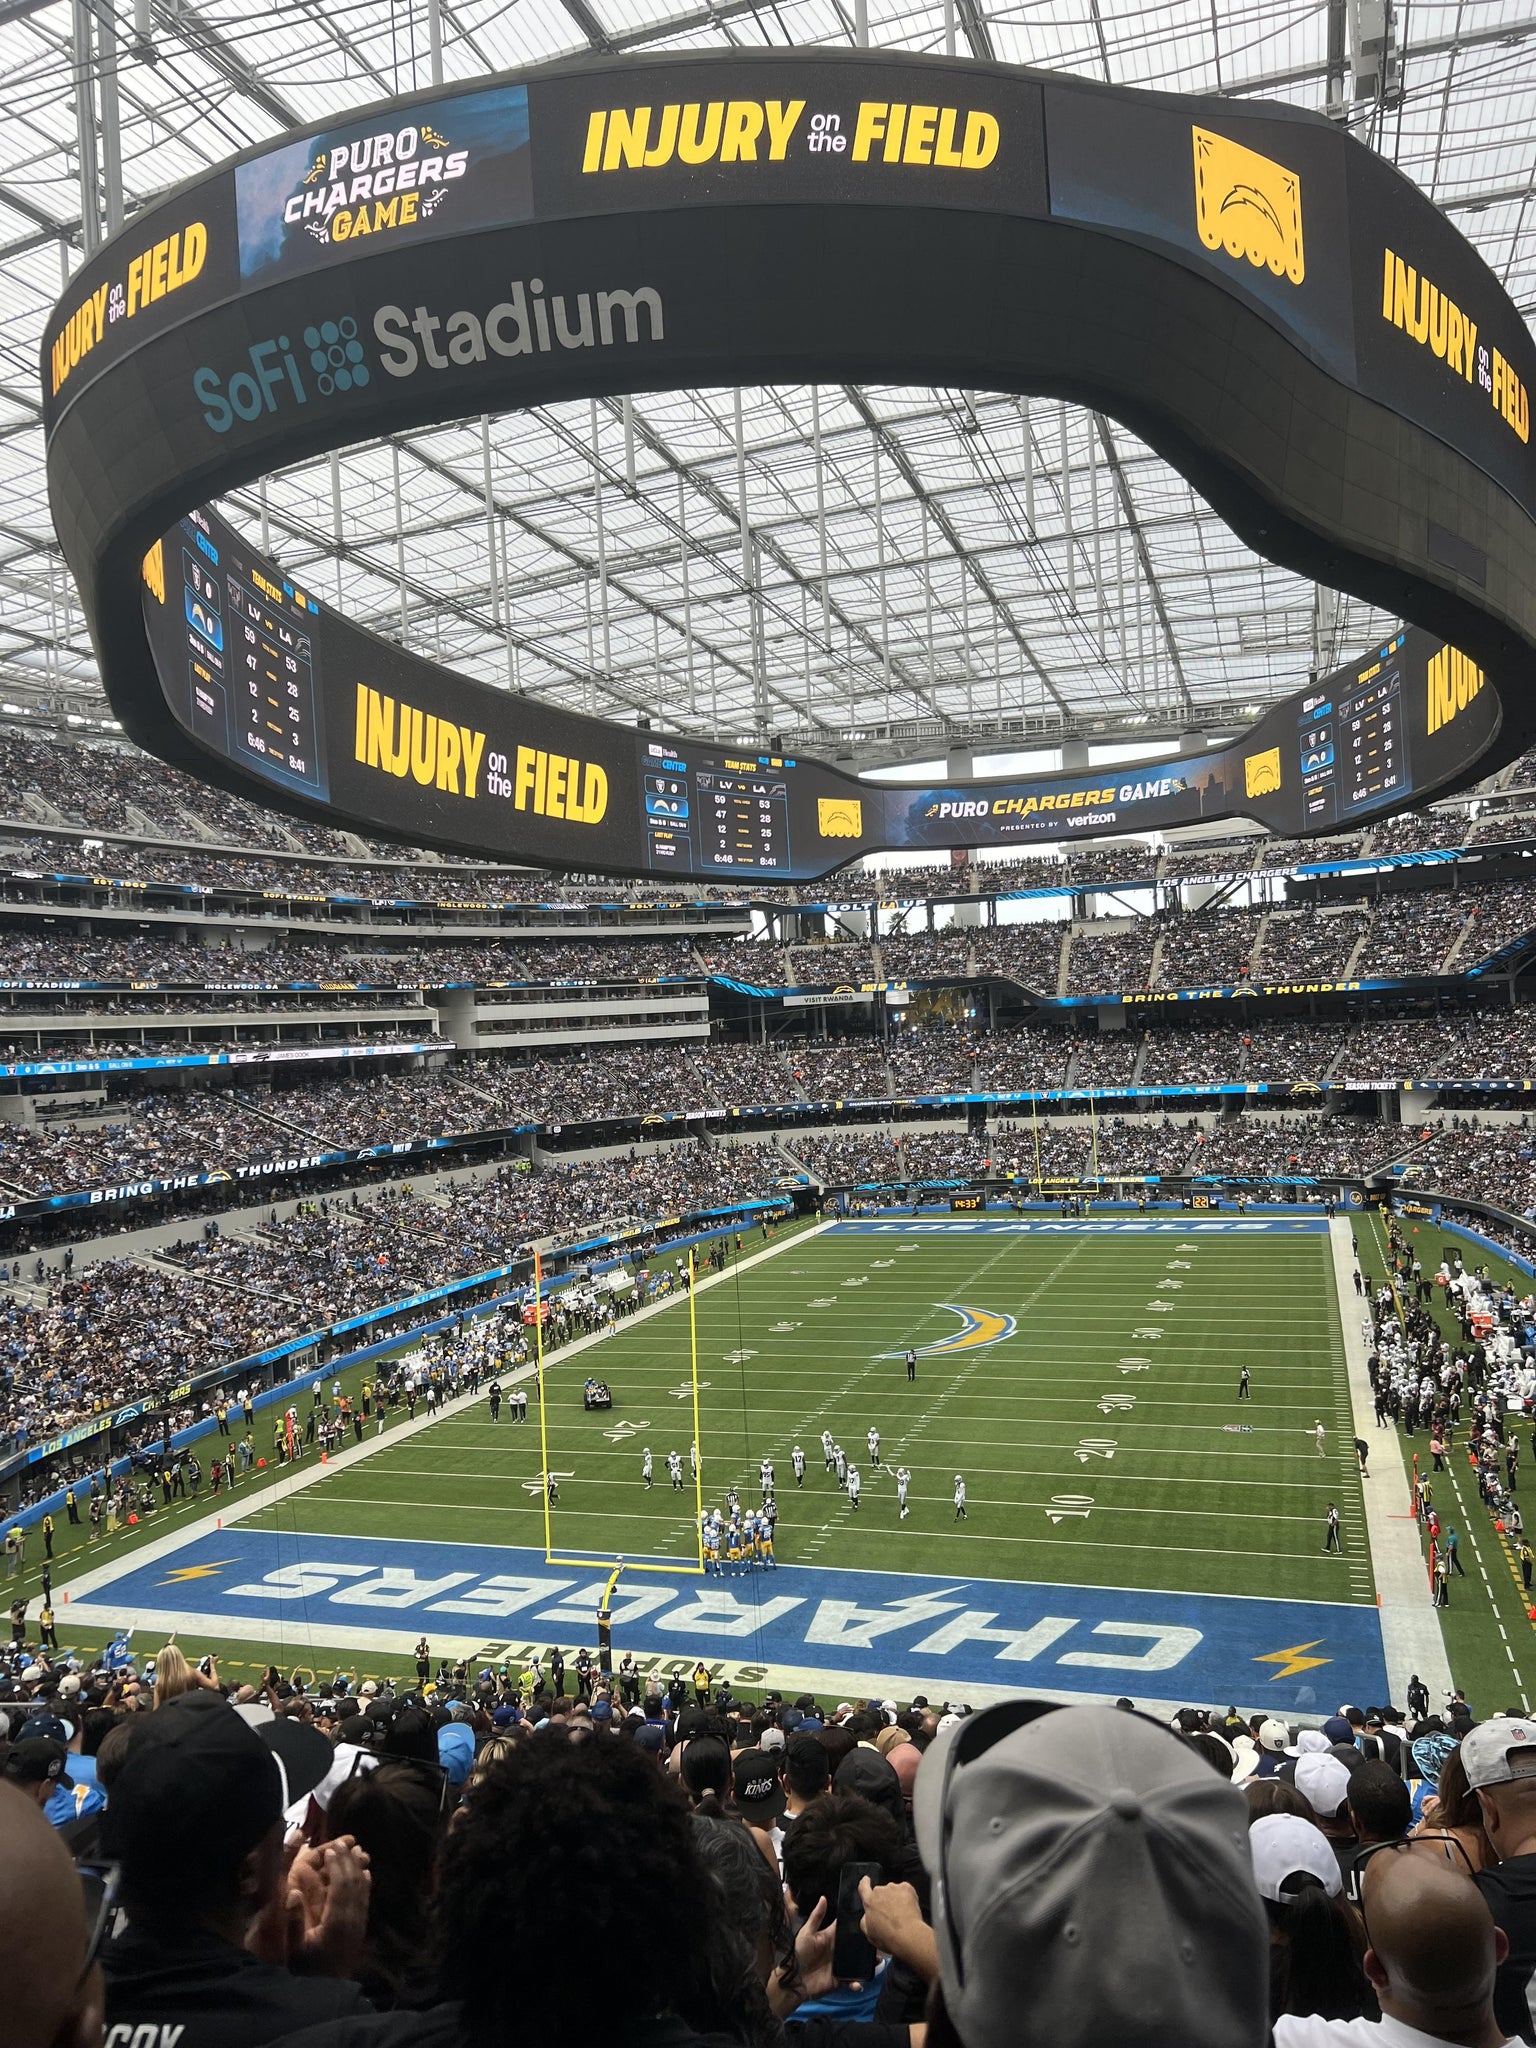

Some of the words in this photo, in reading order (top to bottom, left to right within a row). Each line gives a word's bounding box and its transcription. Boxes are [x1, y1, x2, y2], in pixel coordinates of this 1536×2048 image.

[811, 114, 840, 133] on
[582, 101, 806, 173] INJURY
[807, 131, 847, 153] the
[852, 102, 1000, 170] FIELD
[330, 126, 417, 183] PURO
[284, 150, 468, 225] CHARGERS
[332, 191, 419, 244] GAME
[126, 221, 207, 319] FIELD
[110, 283, 123, 303] on
[108, 298, 126, 323] the
[51, 282, 108, 397] INJURY
[1381, 248, 1477, 384] INJURY
[1491, 346, 1530, 445] FIELD
[193, 337, 307, 433] SoFi
[373, 278, 664, 378] Stadium
[248, 603, 261, 622] LV
[279, 627, 293, 646] LA
[246, 653, 257, 671] 47
[249, 680, 258, 698] 12
[288, 706, 300, 722] 25
[1355, 701, 1365, 712] LV
[1377, 688, 1388, 699] LA
[251, 708, 258, 724] 2
[292, 731, 299, 746] 3
[355, 682, 486, 799] INJURY
[488, 752, 506, 774] on
[662, 759, 688, 773] CENTER
[725, 760, 740, 771] TEAM
[740, 762, 756, 772] STATS
[1356, 772, 1362, 783] 2
[1386, 758, 1392, 769] 3
[487, 772, 512, 798] the
[514, 745, 608, 825] FIELD
[670, 783, 678, 794] 0
[720, 780, 732, 790] LV
[753, 785, 766, 794] LA
[670, 802, 678, 813] 0
[714, 795, 726, 804] 59
[759, 800, 770, 809] 53
[939, 800, 988, 818] PURO
[992, 787, 1116, 820] CHARGERS
[1119, 778, 1172, 802] GAME
[715, 810, 726, 818] 47
[760, 814, 771, 824] 28
[1000, 822, 1045, 832] PRESENTED
[1067, 810, 1116, 828] verizon
[718, 825, 726, 834] 12
[761, 829, 772, 838] 25
[720, 840, 726, 848] 2
[764, 843, 770, 852] 3
[714, 854, 733, 864] 6:46
[760, 858, 776, 866] 8:41
[1157, 879, 1180, 888] LOS
[1183, 873, 1234, 886] ANGELES
[1236, 867, 1298, 882] CHARGERS
[827, 903, 872, 912] BOLT
[861, 984, 876, 992] BOLT
[878, 984, 888, 992] UP
[894, 982, 907, 990] LA
[1122, 993, 1178, 1004] BRING
[1187, 990, 1224, 1000] THE
[1264, 982, 1360, 996] THUNDER
[1344, 1082, 1370, 1090] SEASON
[1370, 1082, 1396, 1090] TICKETS
[686, 1112, 705, 1120] SEASON
[706, 1110, 726, 1118] TICKETS
[427, 1139, 437, 1148] LA
[90, 1183, 152, 1204] BRING
[160, 1175, 198, 1192] THE
[236, 1156, 322, 1178] THUNDER
[954, 1200, 977, 1210] 14:33
[1195, 1196, 1206, 1206] 22
[987, 1223, 1273, 1232] ANGELES
[1097, 1394, 1136, 1411] 30
[42, 1439, 63, 1457] LOS
[64, 1416, 112, 1447] ANGELES
[603, 1420, 650, 1438] 20
[1074, 1438, 1118, 1459] 20
[1045, 1494, 1095, 1519] 10
[222, 1561, 1204, 1672] CHARGERS
[633, 1655, 769, 1684] STOP
[744, 1778, 773, 1796] KINGS
